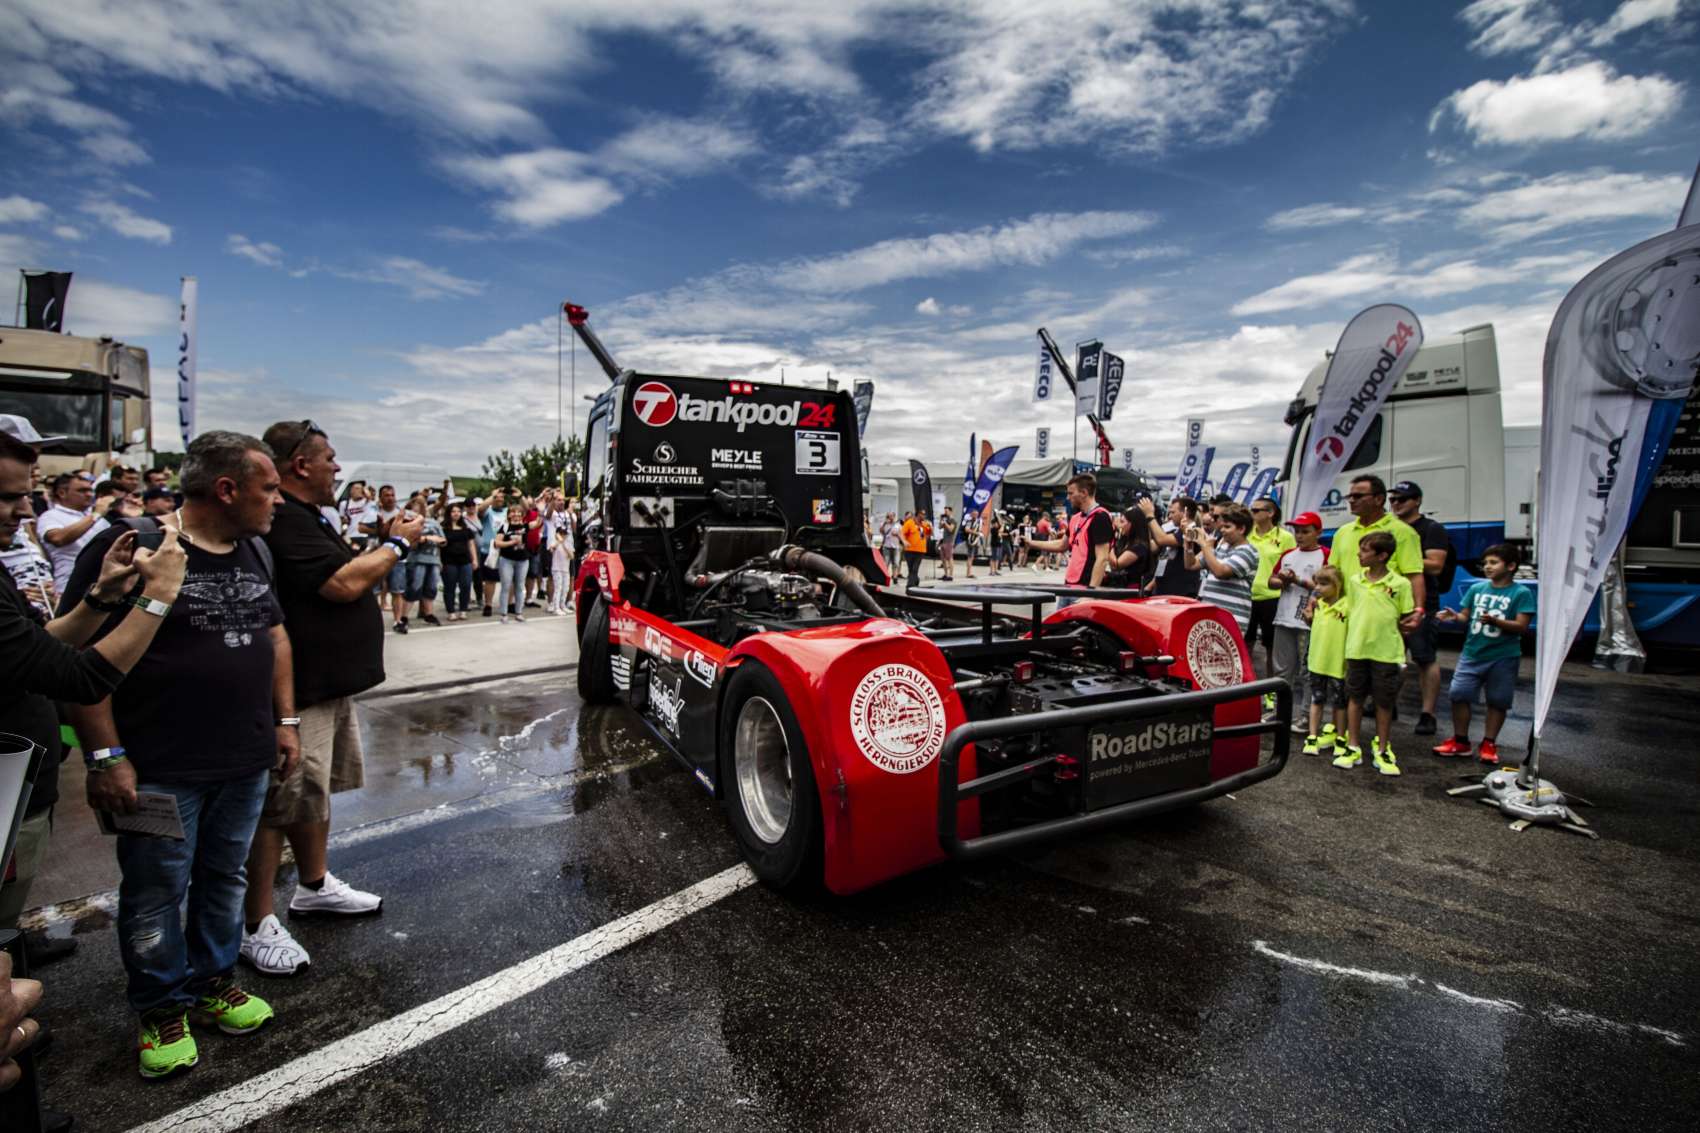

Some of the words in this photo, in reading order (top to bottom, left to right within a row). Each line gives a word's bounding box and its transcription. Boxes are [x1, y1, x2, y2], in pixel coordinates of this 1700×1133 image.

[1333, 320, 1415, 437] tankpool24
[678, 393, 837, 432] tankpool24
[711, 448, 763, 464] MEYLE
[809, 441, 827, 467] 3
[625, 474, 705, 485] FAHRZEUGTEILE
[1474, 593, 1511, 610] LET'S
[1189, 623, 1204, 661] SCHLOSS
[1205, 621, 1239, 658] BRAUEREI
[853, 671, 882, 727] SCHLOSS
[887, 667, 940, 709] BRAUEREI
[860, 721, 943, 771] HERRNGIERSDORF
[1091, 722, 1212, 761] RoadStars
[1089, 764, 1122, 782] powered
[1124, 763, 1133, 774] by
